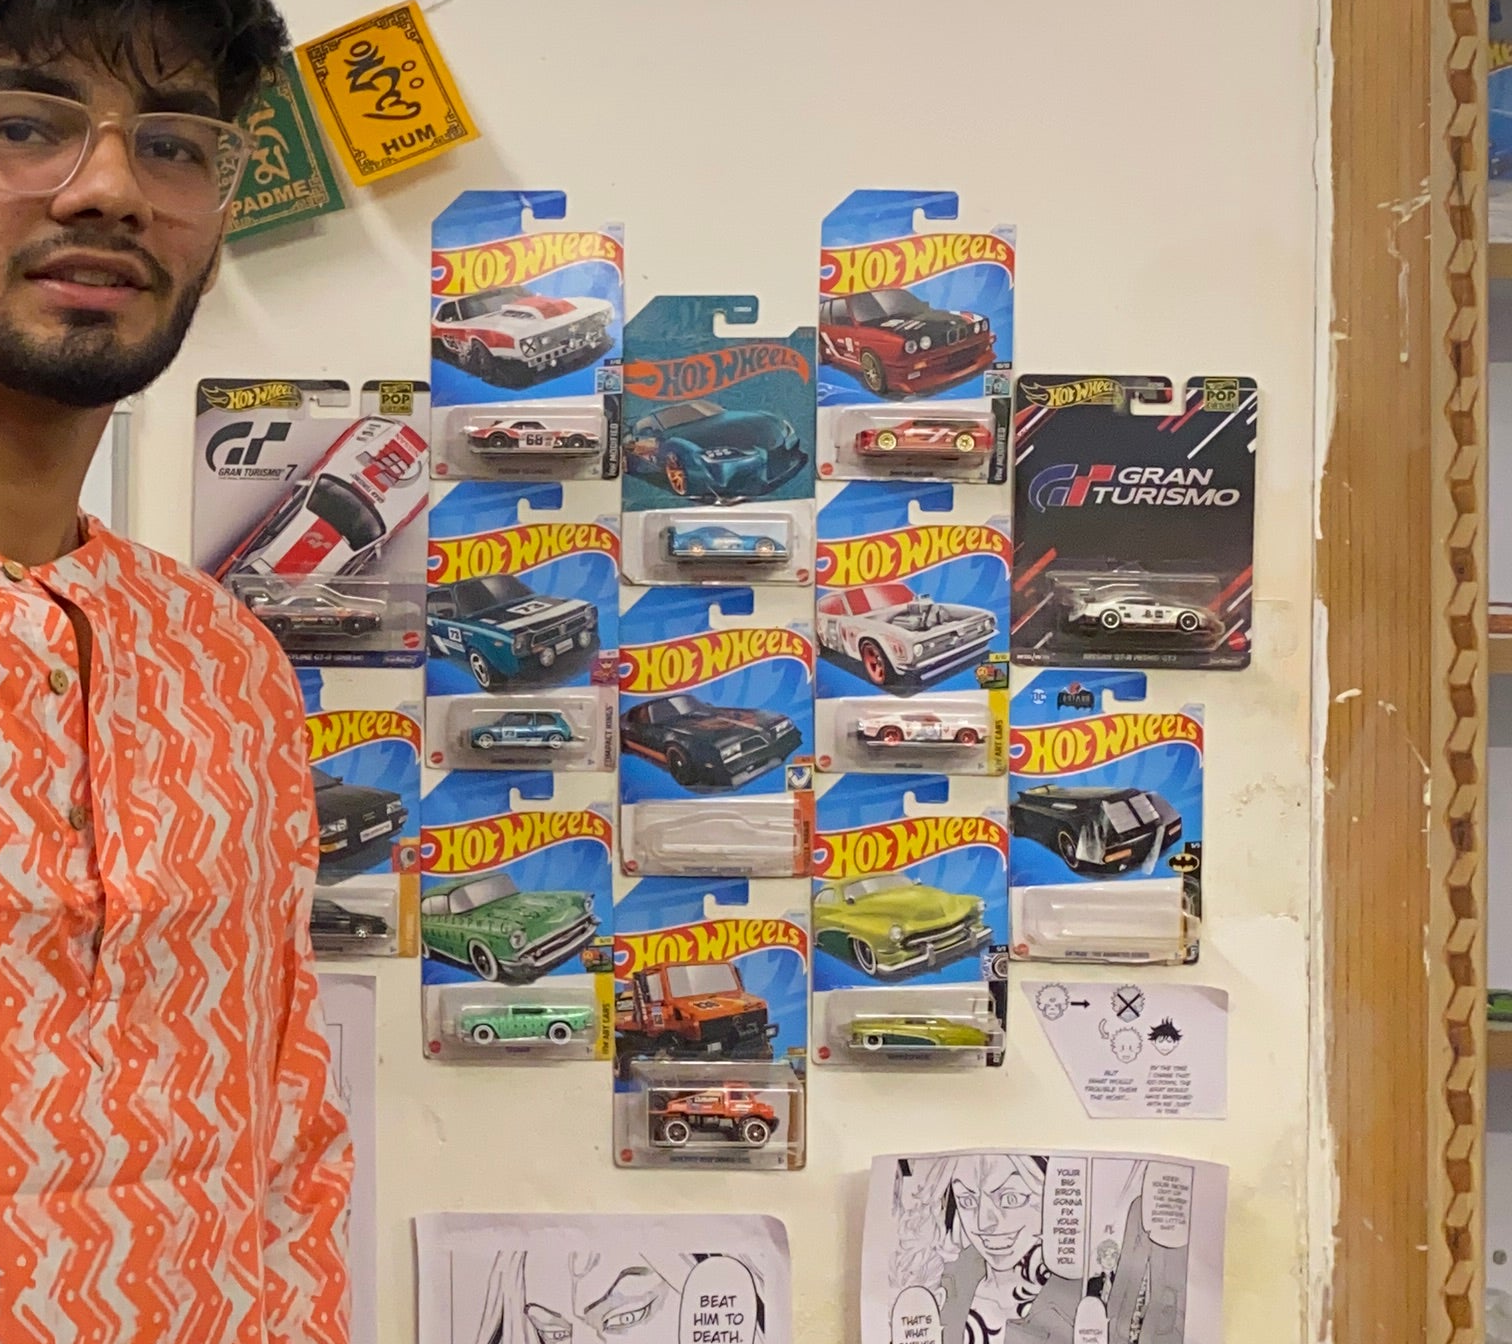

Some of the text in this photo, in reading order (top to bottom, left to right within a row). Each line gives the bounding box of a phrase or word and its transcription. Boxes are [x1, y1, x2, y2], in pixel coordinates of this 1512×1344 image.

[380, 123, 437, 155] HUM
[232, 179, 310, 217] PADME
[382, 394, 410, 404] POP
[1207, 391, 1237, 401] POP
[525, 433, 543, 446] 68
[609, 423, 620, 461] MODIFIED
[284, 464, 298, 481] 7
[1118, 467, 1213, 485] GRAN
[1093, 487, 1240, 506] TURISMO
[519, 602, 546, 616] 73
[449, 630, 460, 641] 73
[995, 719, 1003, 740] CARS
[1053, 1198, 1083, 1206] GONNA
[1061, 1208, 1074, 1216] FIX
[1058, 1247, 1076, 1255] FOR
[700, 1295, 737, 1307] BEAT
[694, 1313, 744, 1325] HIM TO
[901, 1315, 932, 1325] THAT'S
[693, 1330, 743, 1343] DEATH.
[905, 1328, 929, 1339] WHAT
